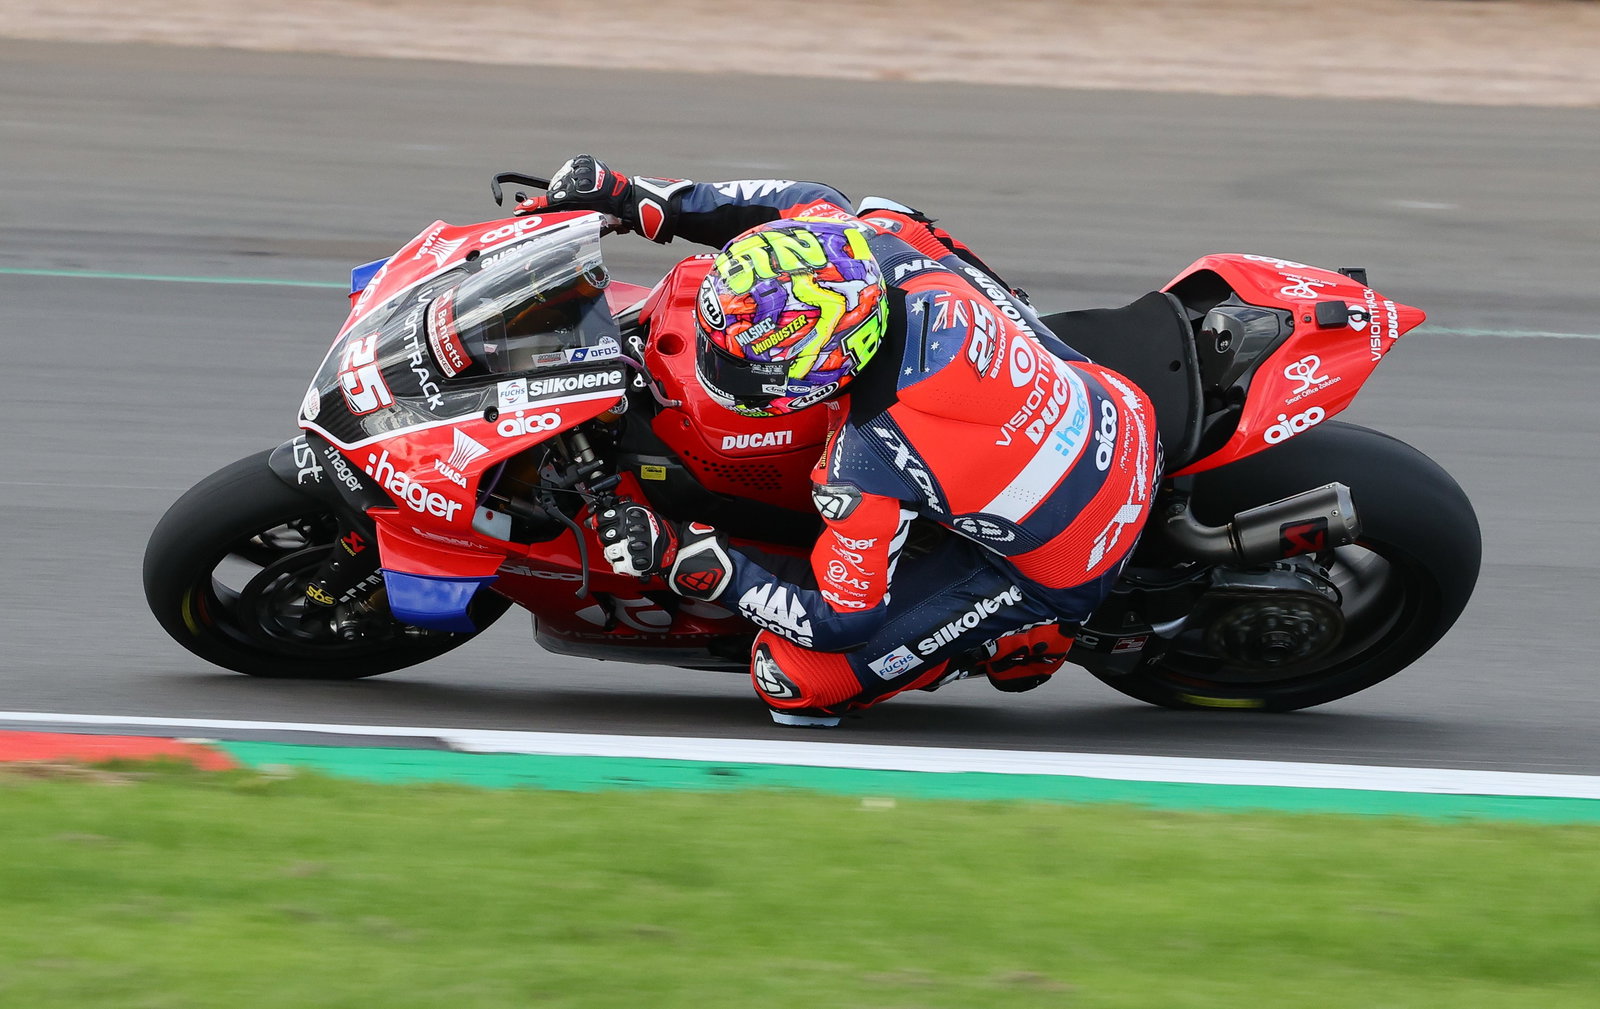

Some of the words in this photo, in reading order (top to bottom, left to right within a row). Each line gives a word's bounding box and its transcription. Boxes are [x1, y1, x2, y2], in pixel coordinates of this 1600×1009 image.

[412, 226, 445, 260] YUASA
[479, 216, 542, 243] aico
[734, 317, 777, 347] MILSPEC
[1364, 288, 1382, 362] VISIONTRACK
[1383, 300, 1399, 340] DUCATI
[438, 308, 464, 368] Bennetts
[590, 346, 619, 358] DFDS
[967, 299, 997, 378] 25
[339, 333, 395, 414] 25
[528, 370, 622, 396] Silkolene
[500, 387, 526, 398] FUCHS
[496, 410, 562, 438] aico
[721, 430, 793, 450] DUCATI
[1094, 399, 1118, 472] aico
[1263, 406, 1325, 445] aico
[433, 458, 468, 489] YUASA
[306, 585, 335, 605] sbs
[738, 605, 814, 648] TOOLS
[917, 584, 1023, 656] Silkolene
[879, 653, 914, 677] FUCHS
